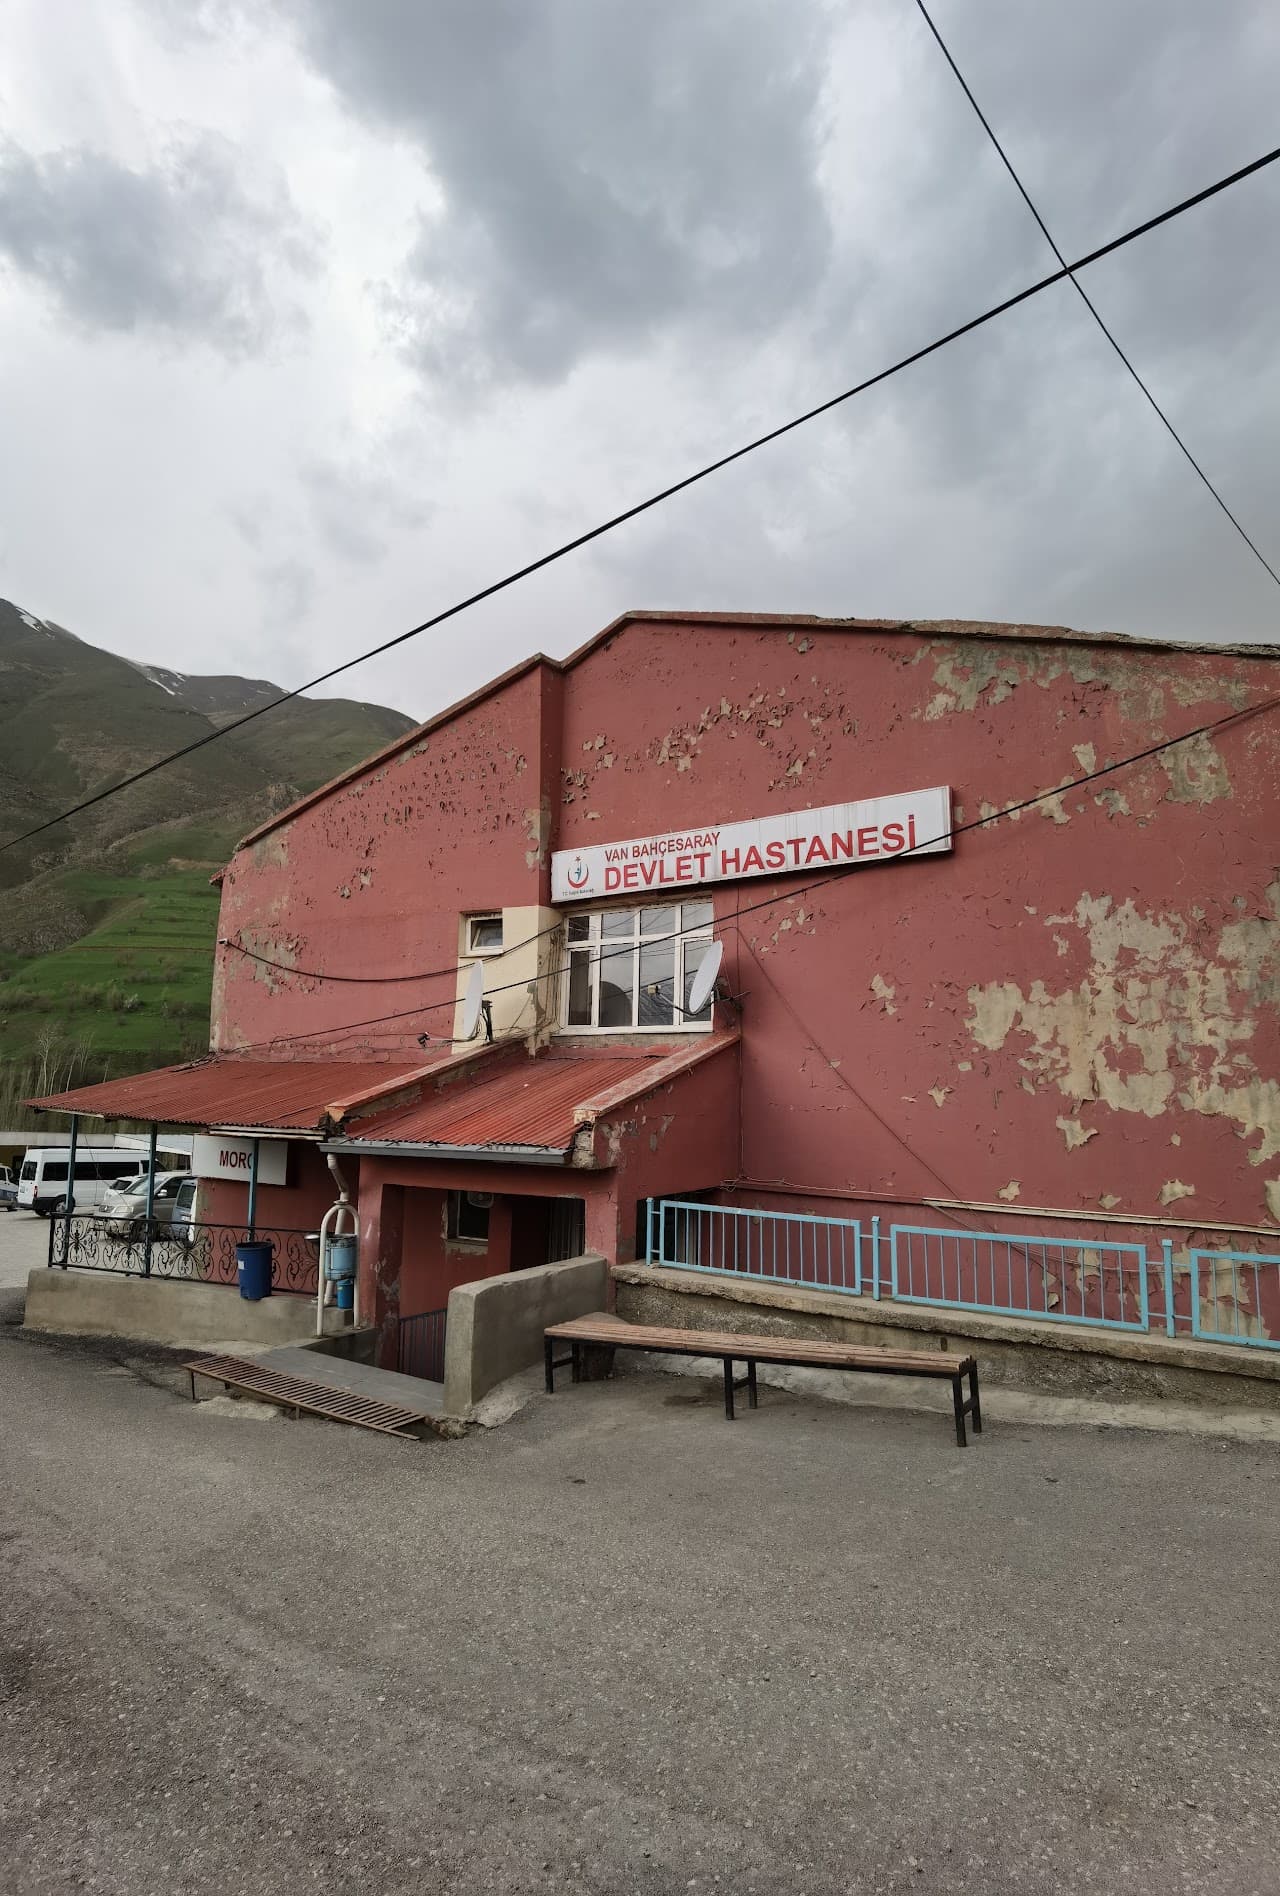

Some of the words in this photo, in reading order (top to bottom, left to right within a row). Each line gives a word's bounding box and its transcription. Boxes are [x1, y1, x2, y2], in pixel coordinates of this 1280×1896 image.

[605, 847, 628, 862] VAN
[632, 831, 720, 858] BAHÇESARAY
[605, 852, 711, 891] DEVLET
[721, 814, 916, 875] HASTANESİ
